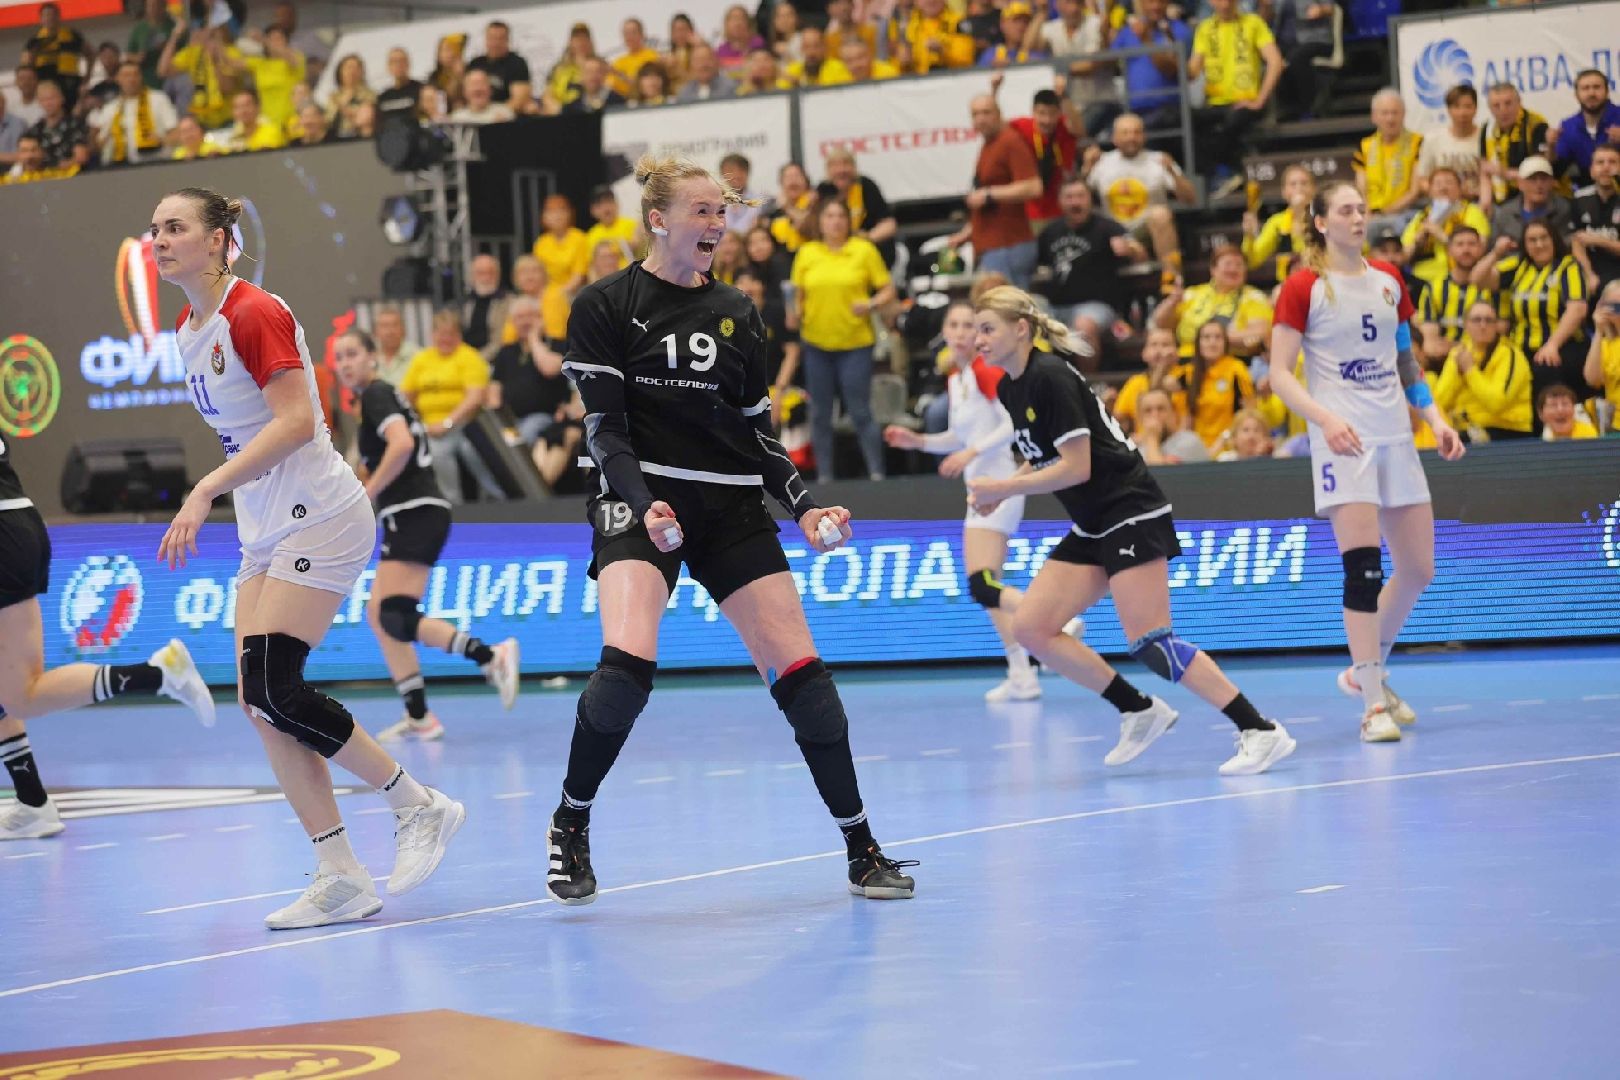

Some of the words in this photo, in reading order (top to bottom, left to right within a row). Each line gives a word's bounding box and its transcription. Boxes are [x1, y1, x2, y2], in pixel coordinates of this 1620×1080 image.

[1361, 313, 1378, 342] 5
[660, 332, 718, 372] 19
[190, 374, 220, 415] 11
[1321, 463, 1336, 493] 5
[601, 502, 633, 532] 19
